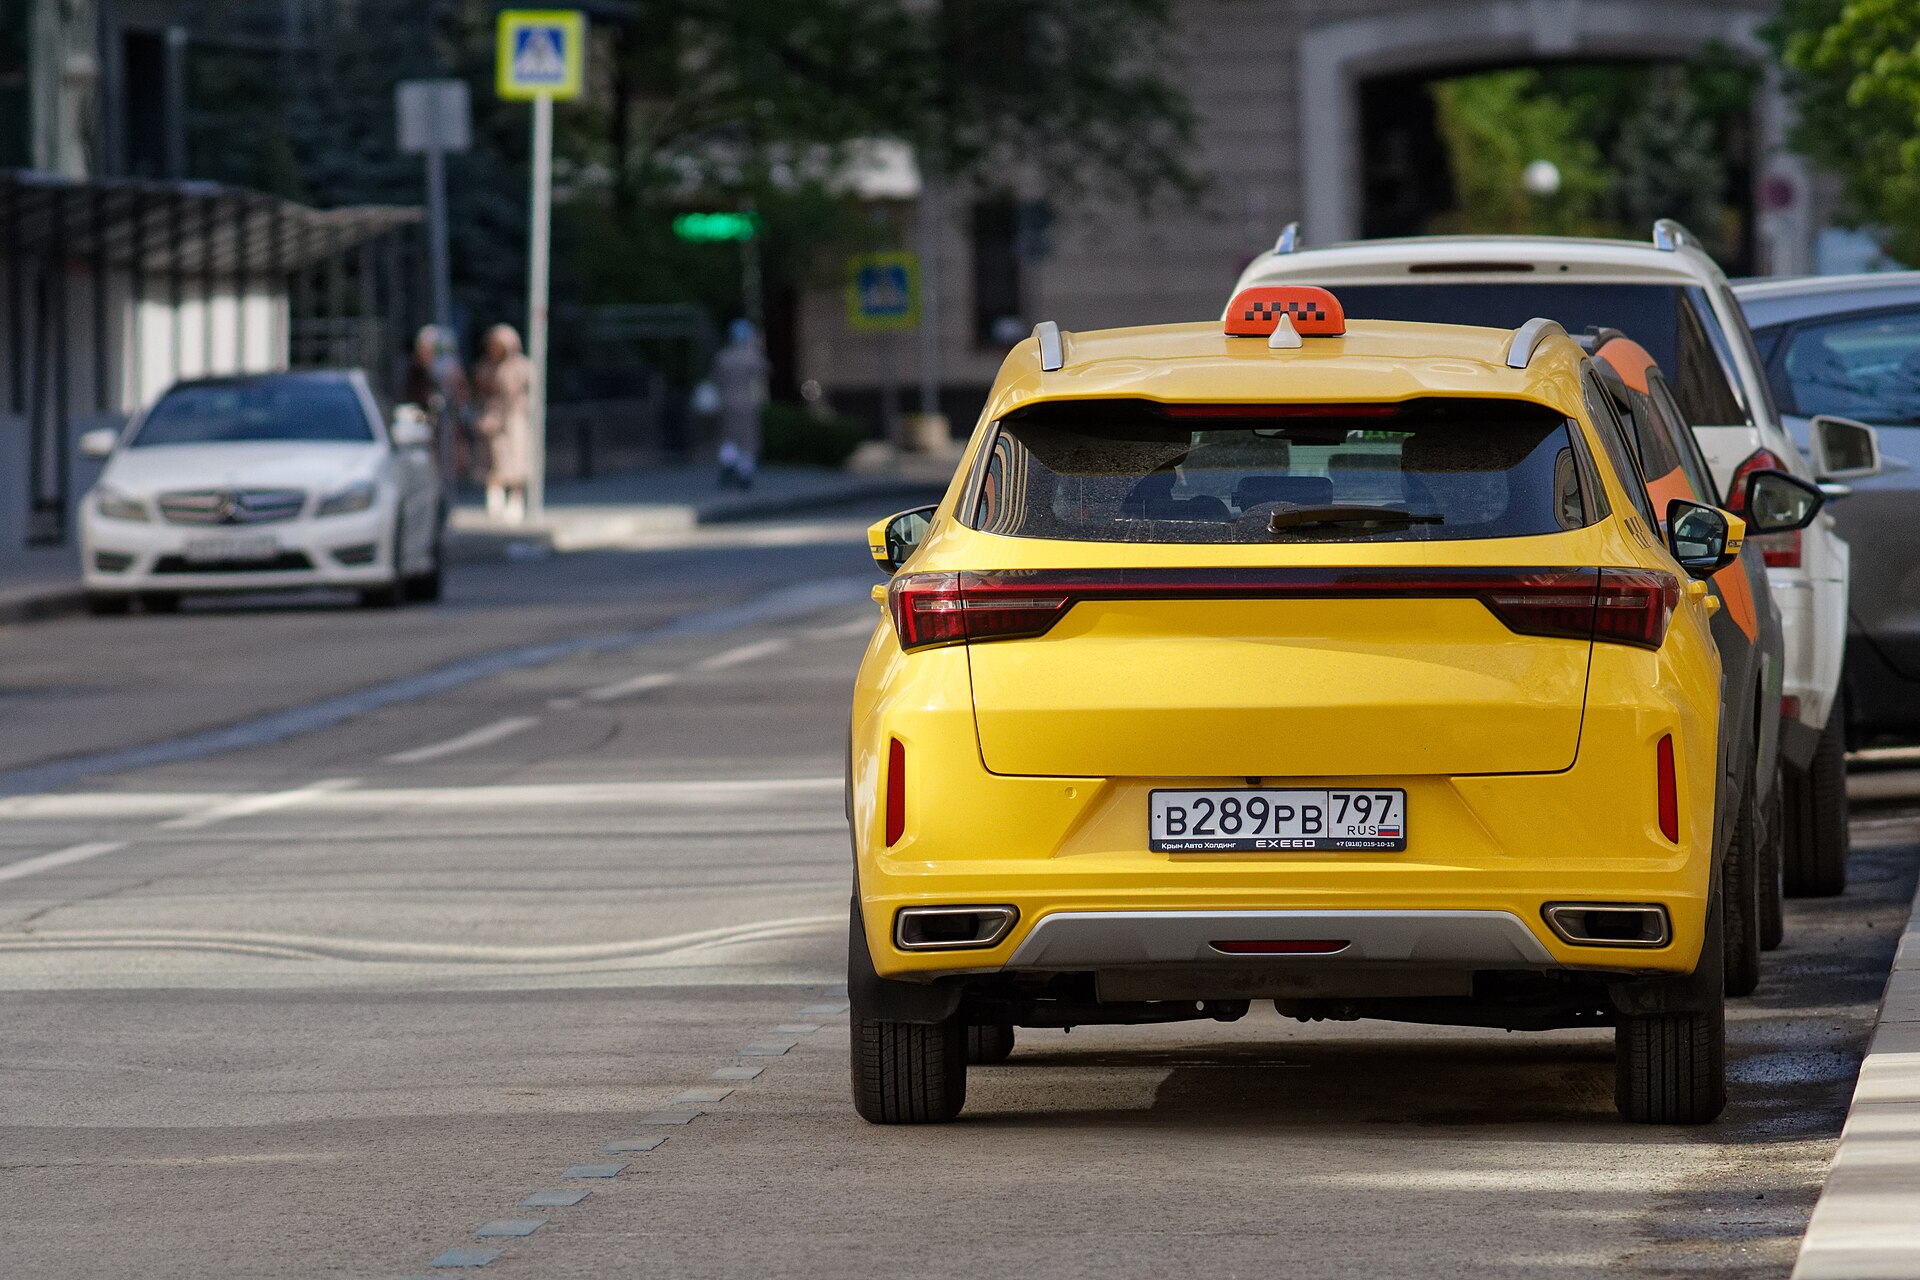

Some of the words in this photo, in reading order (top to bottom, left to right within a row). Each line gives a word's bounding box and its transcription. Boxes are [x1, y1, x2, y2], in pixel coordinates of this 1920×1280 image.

[1332, 795, 1393, 824] 797
[1347, 825, 1377, 835] RUS
[1161, 842, 1183, 850] Крым
[1204, 841, 1237, 850] Холдинг
[1255, 839, 1316, 848] EXEED
